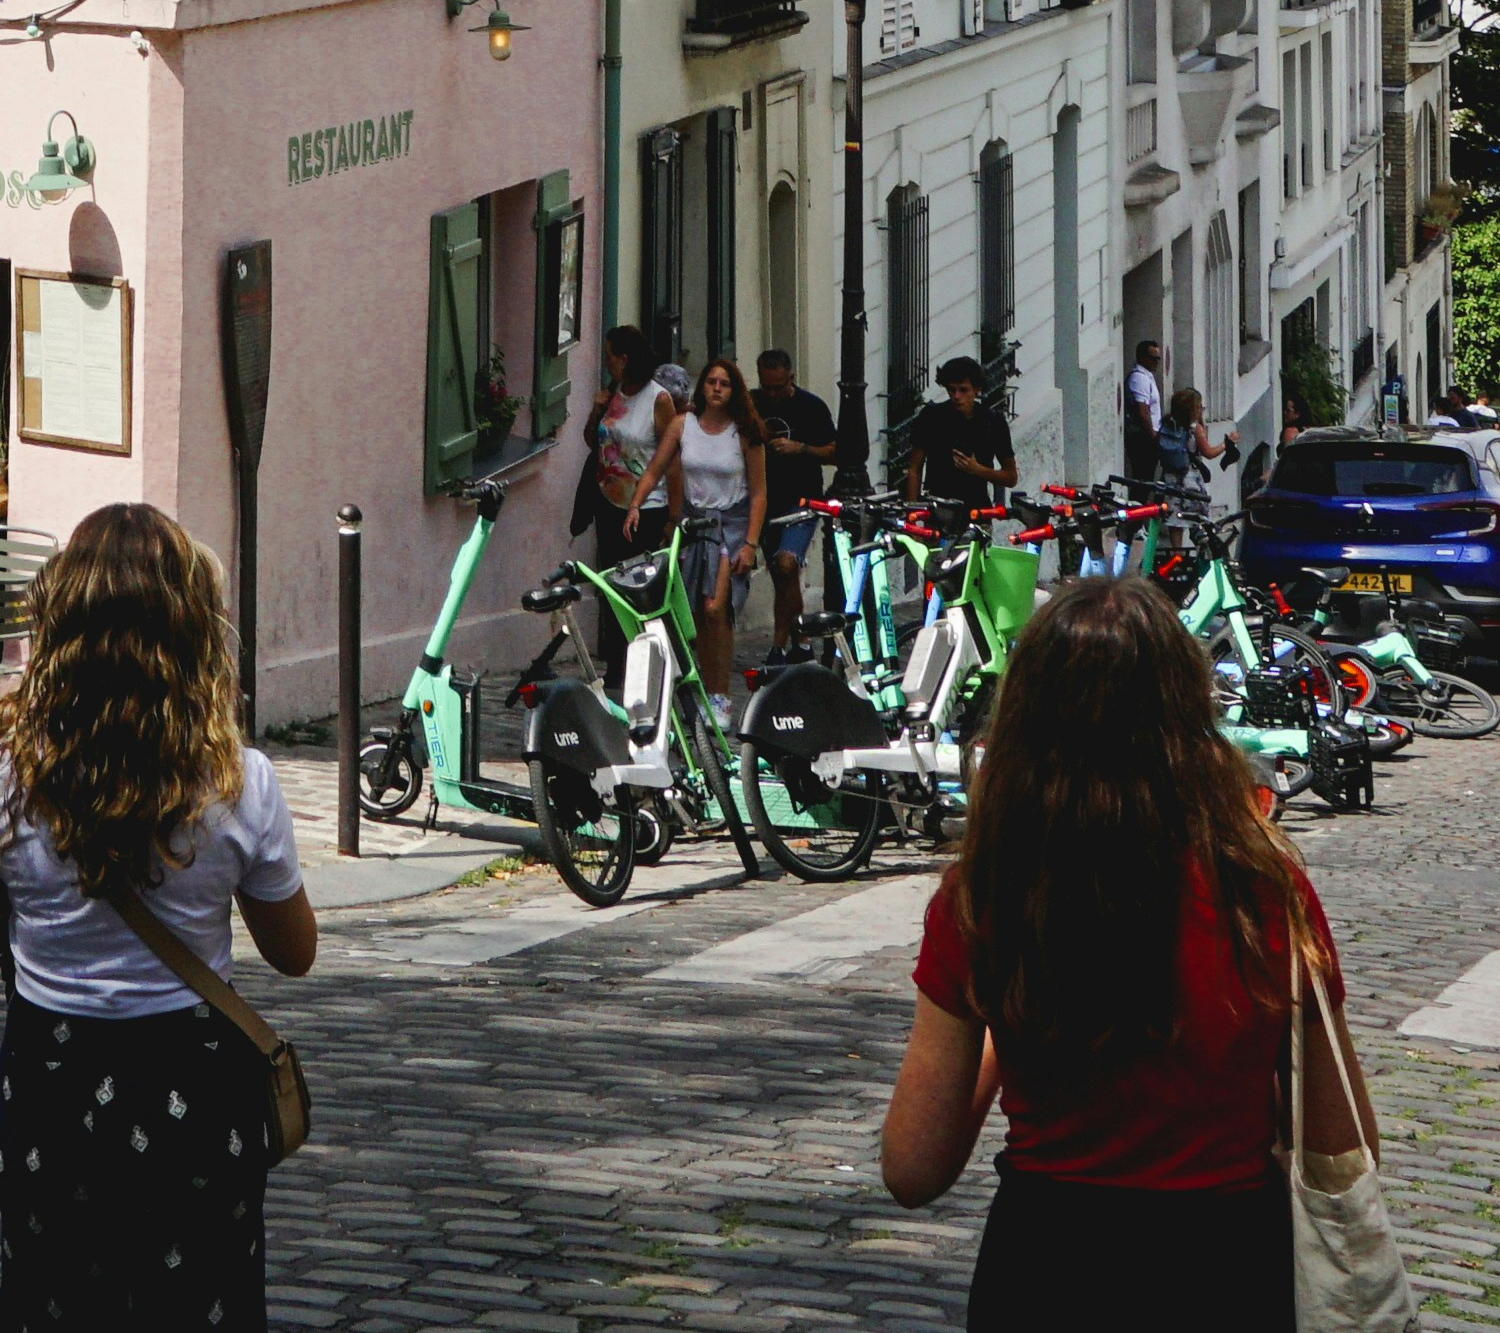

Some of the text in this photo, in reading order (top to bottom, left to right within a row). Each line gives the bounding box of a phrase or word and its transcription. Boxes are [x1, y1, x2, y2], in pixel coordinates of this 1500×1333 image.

[288, 110, 413, 186] RESTAURANT
[855, 622, 868, 659] TIE
[428, 722, 445, 768] TIER
